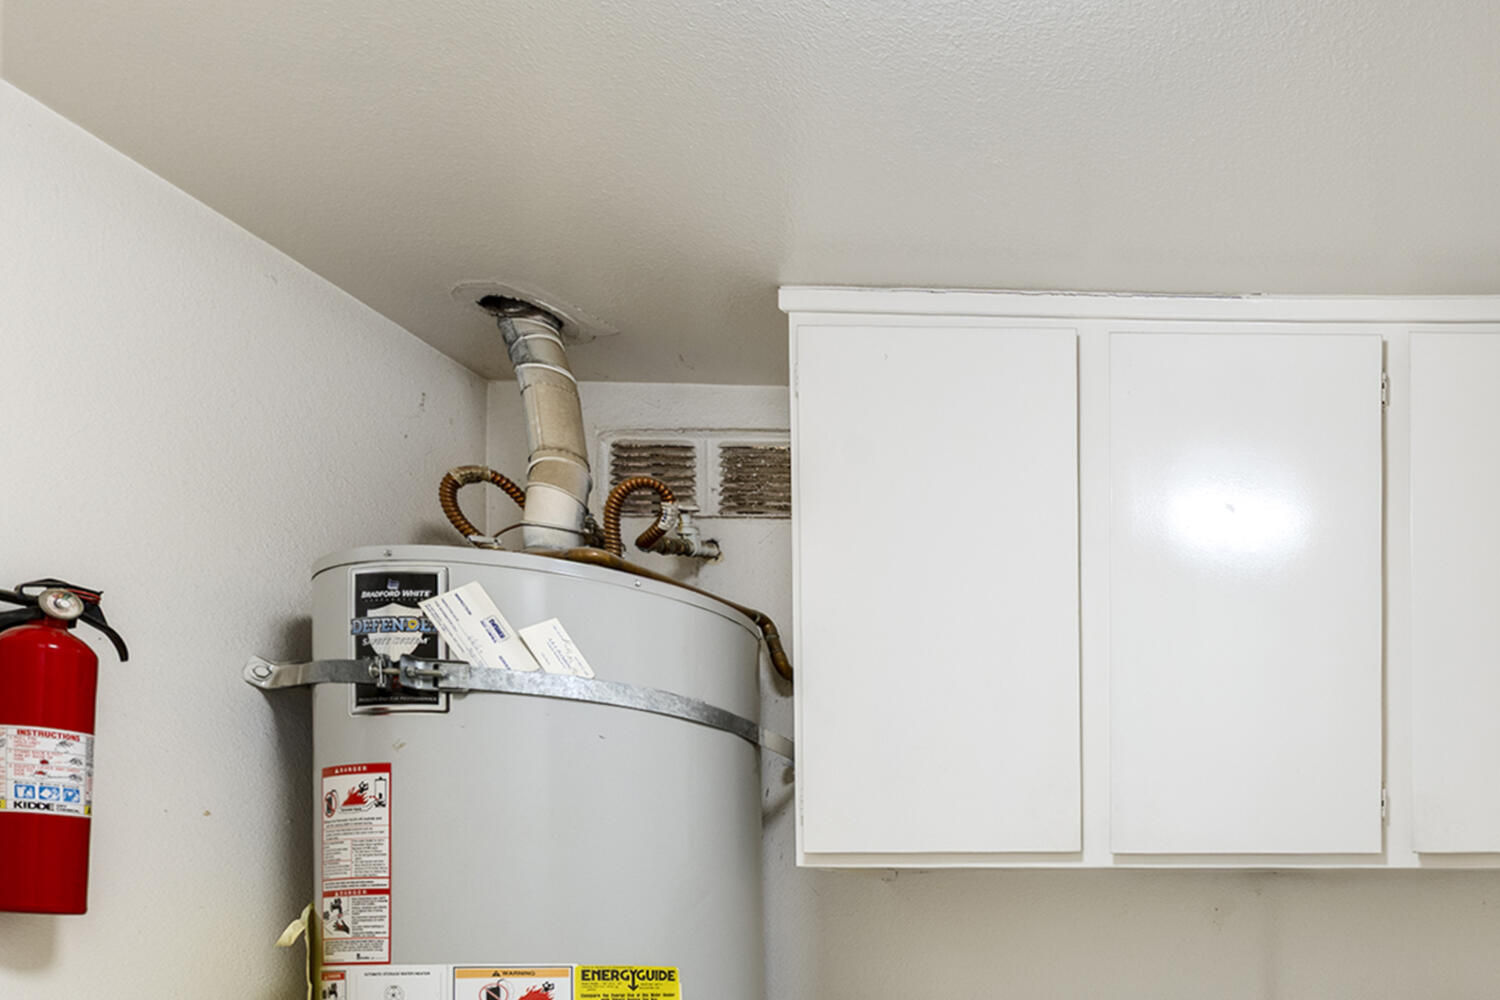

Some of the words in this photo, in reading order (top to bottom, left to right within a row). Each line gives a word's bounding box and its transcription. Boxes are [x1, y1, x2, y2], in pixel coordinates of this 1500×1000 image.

[361, 590, 401, 599] BRADFORD
[402, 589, 432, 598] WHITE
[17, 729, 80, 742] INSTRUCTIONS
[13, 800, 54, 812] KIDDE
[581, 969, 676, 984] ENERGYGUIDE
